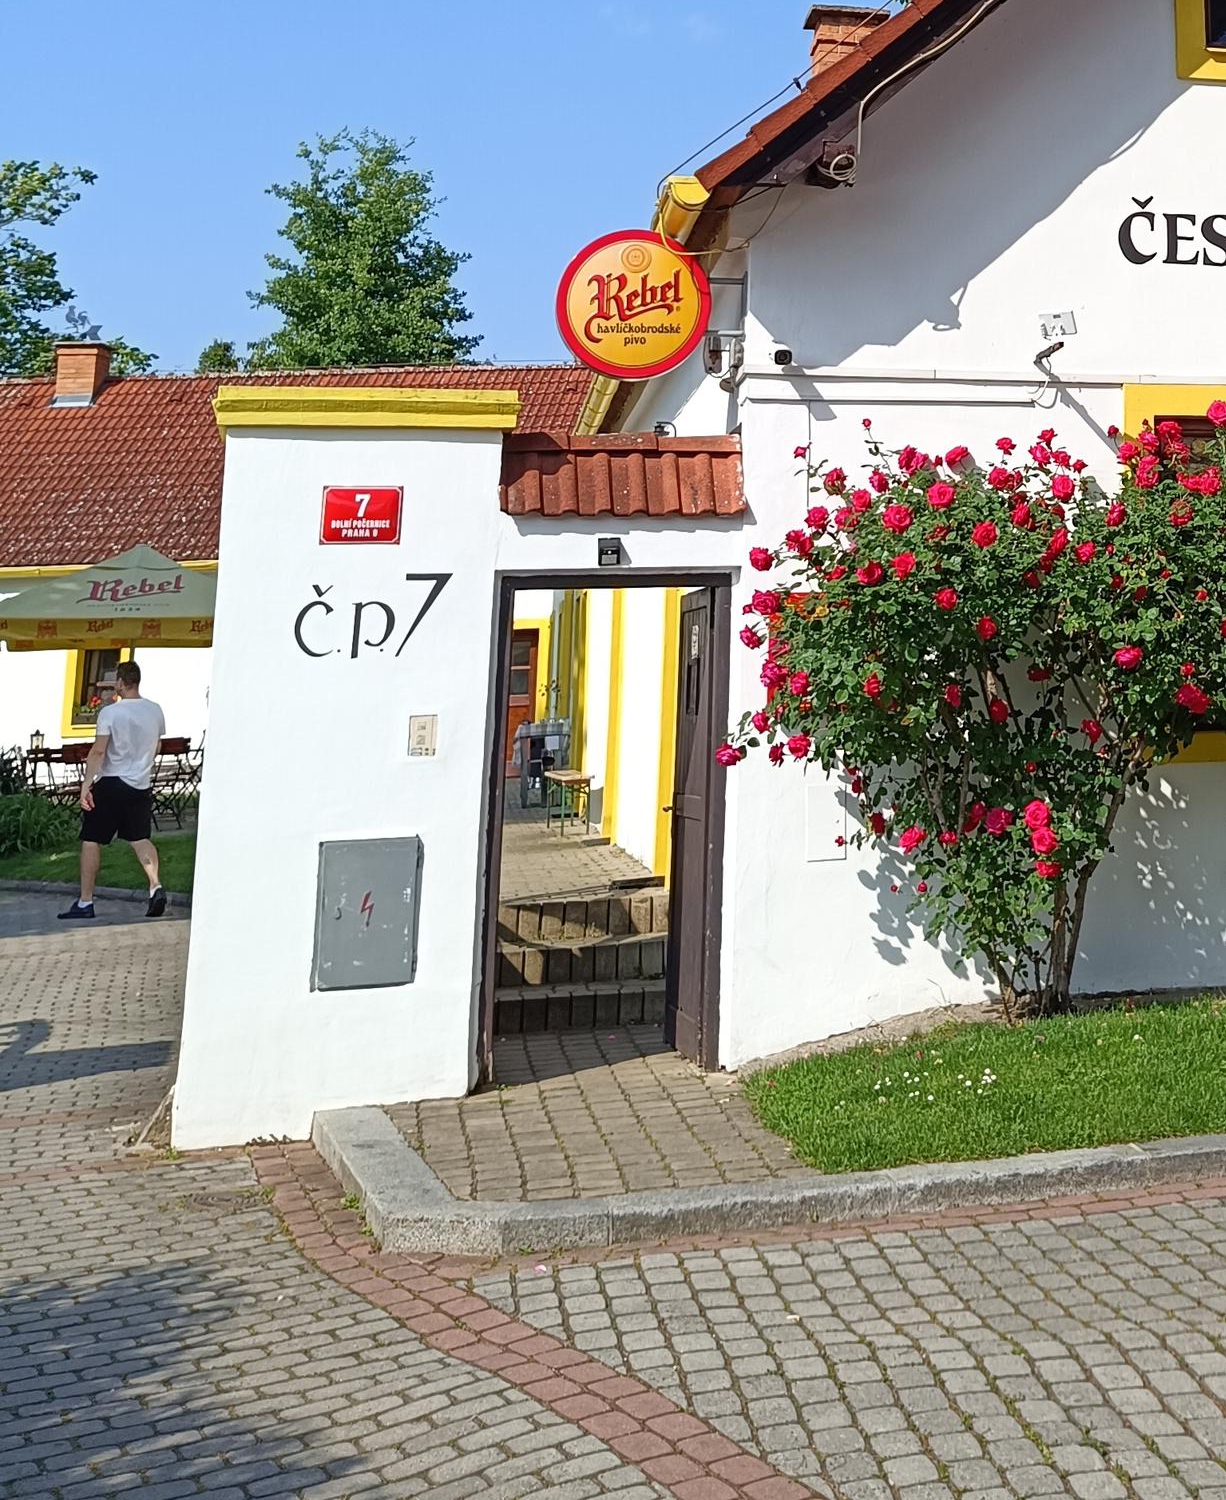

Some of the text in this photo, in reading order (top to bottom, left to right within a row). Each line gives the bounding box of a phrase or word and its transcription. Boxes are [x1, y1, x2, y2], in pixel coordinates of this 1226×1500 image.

[585, 268, 684, 322] Rebel
[596, 322, 681, 334] havlíčkobrodské
[623, 334, 647, 347] pivo
[354, 493, 372, 518] 7
[341, 528, 371, 538] PRAHA
[77, 573, 185, 604] Rebel
